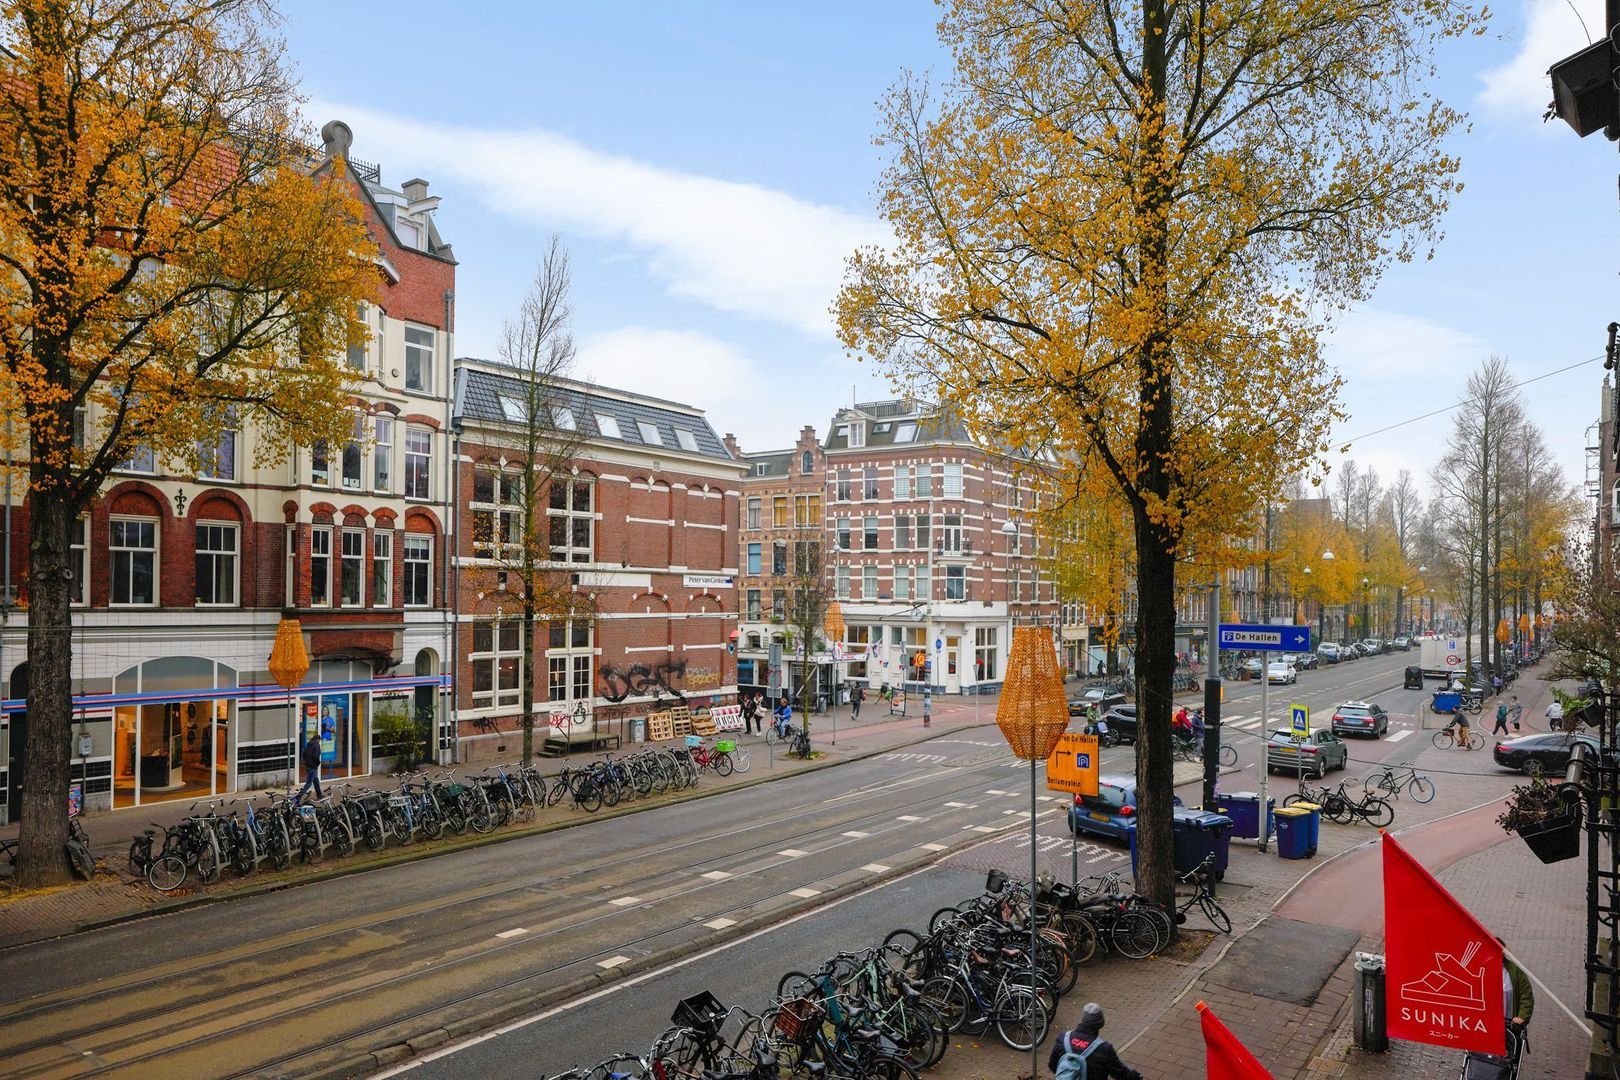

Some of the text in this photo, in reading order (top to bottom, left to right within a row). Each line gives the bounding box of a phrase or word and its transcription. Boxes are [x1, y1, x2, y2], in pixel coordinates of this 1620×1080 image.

[1235, 632, 1278, 642] De Hallen
[1080, 735, 1097, 744] Hallen
[1401, 1007, 1487, 1033] SUNIKA
[1428, 1030, 1460, 1040] スニーカー
